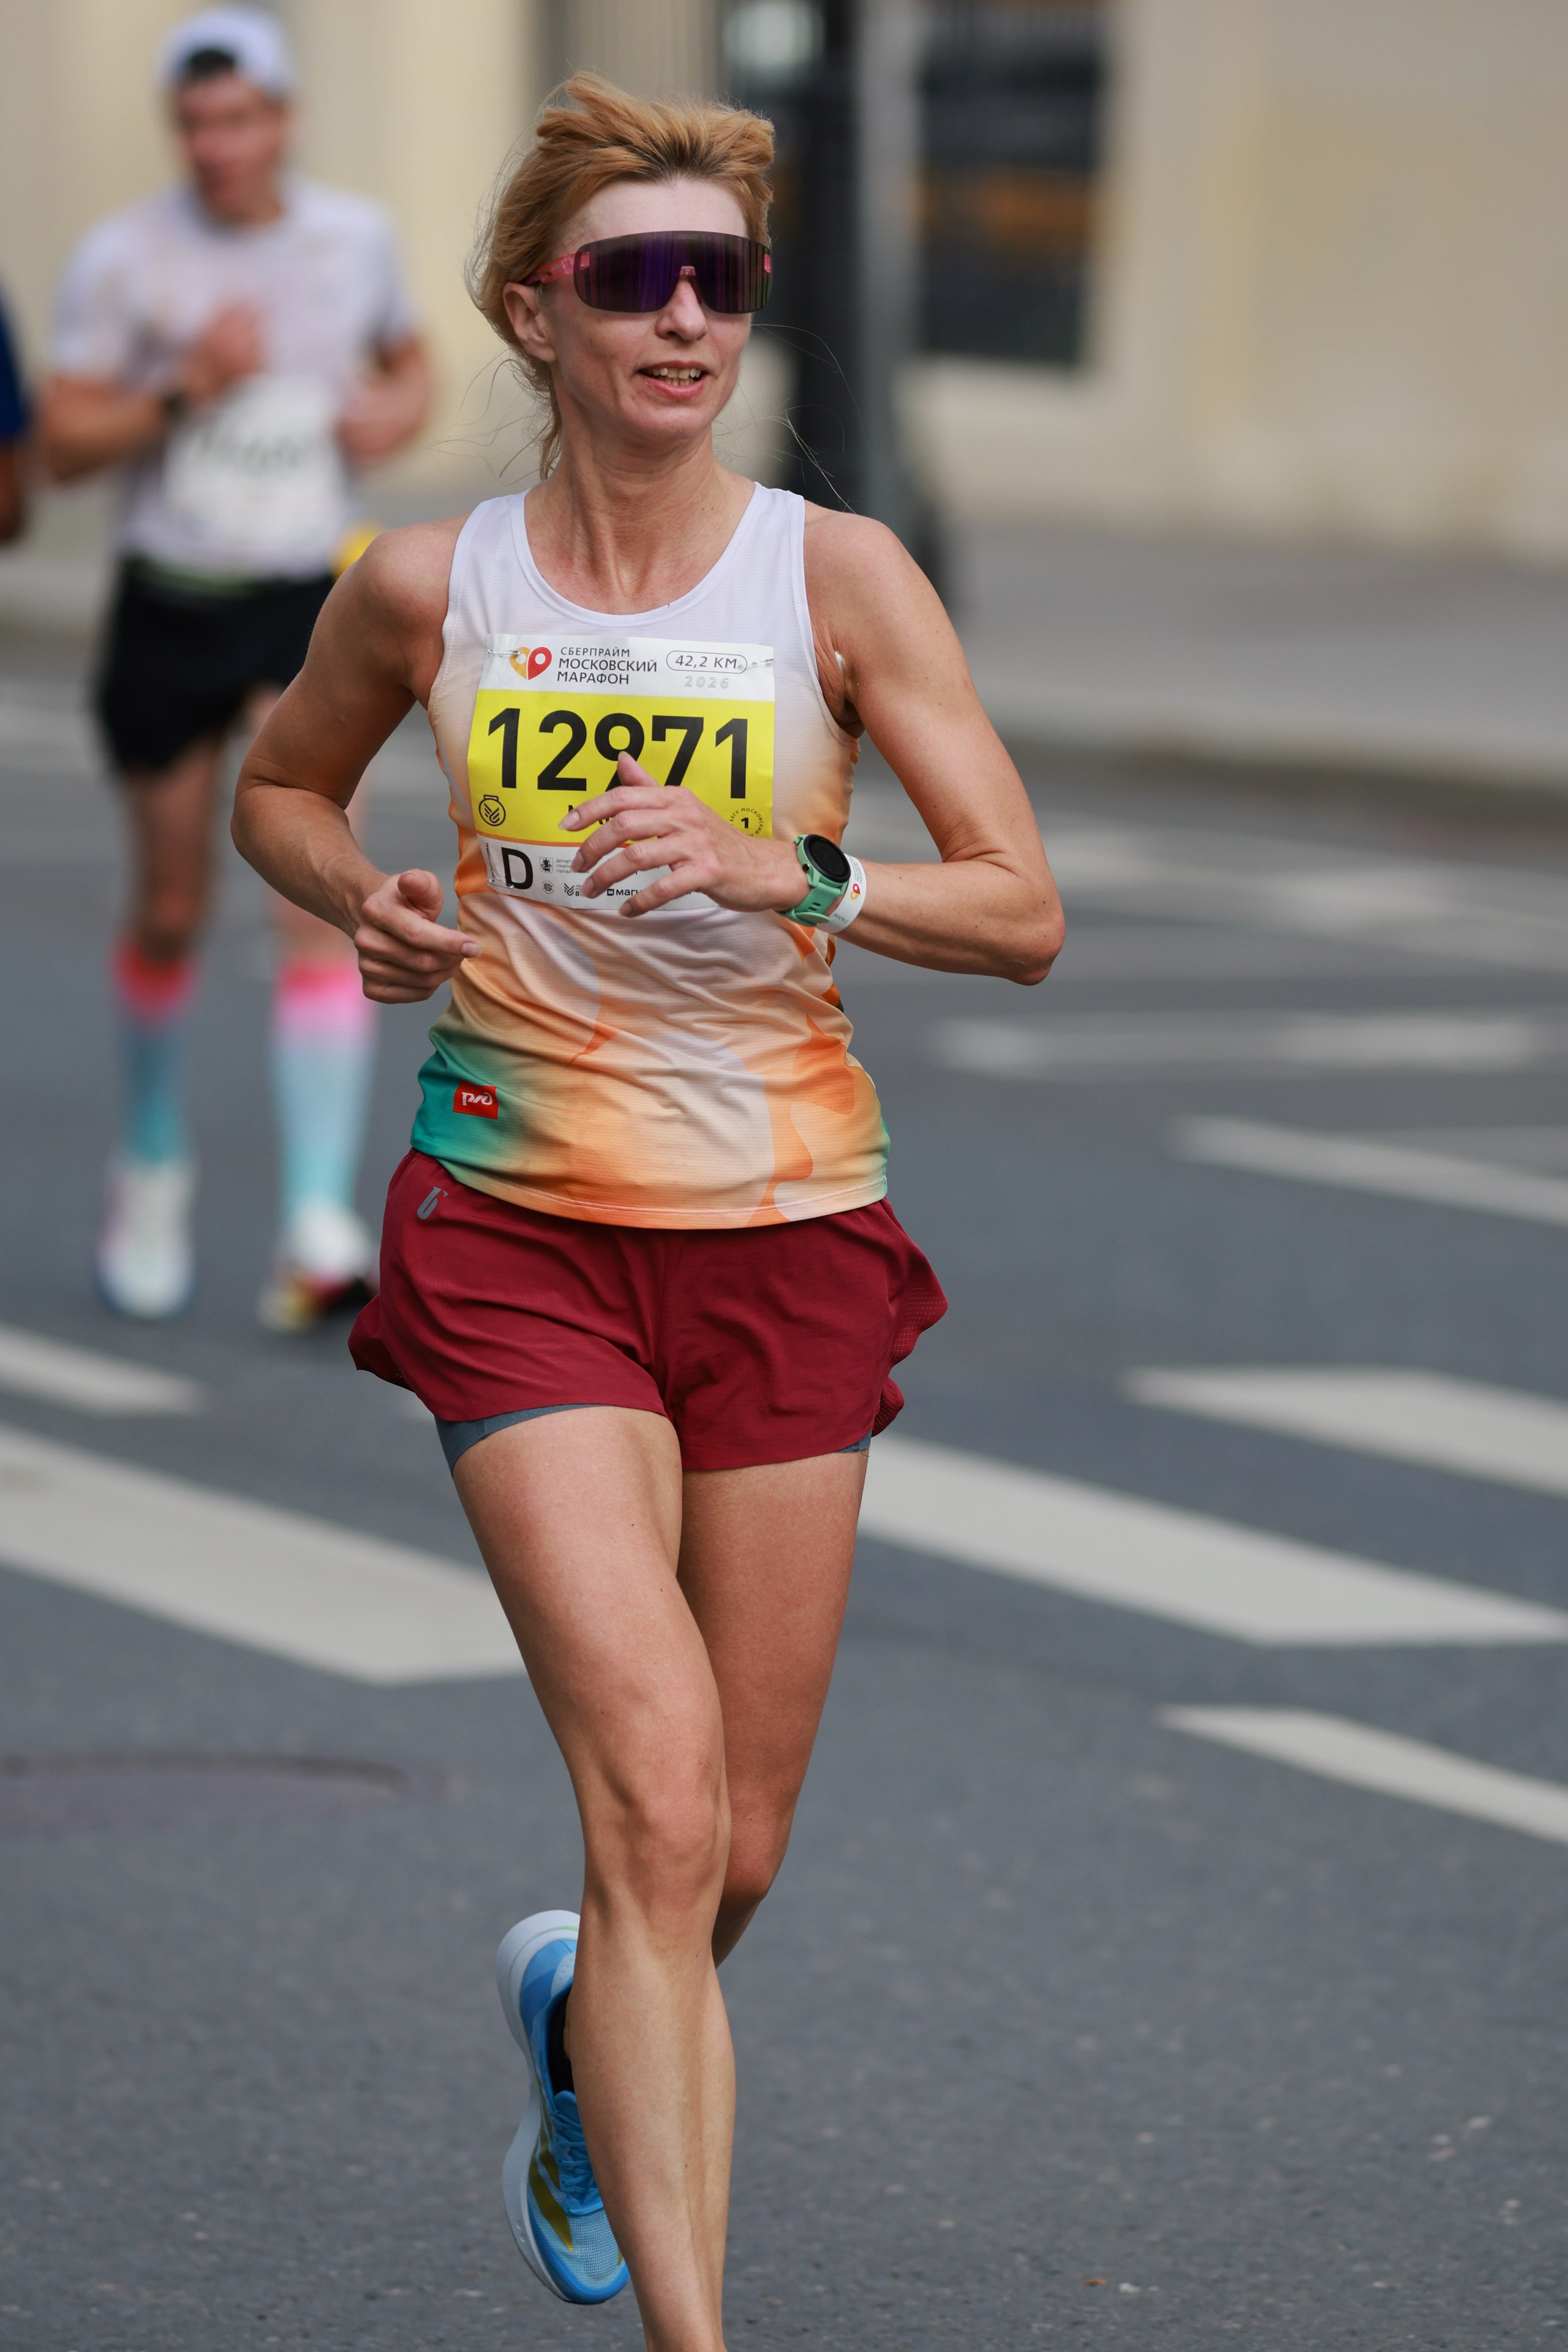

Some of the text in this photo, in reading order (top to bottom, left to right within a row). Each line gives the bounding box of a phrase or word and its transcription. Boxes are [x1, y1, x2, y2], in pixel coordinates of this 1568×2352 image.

[561, 647, 630, 657] СБЕРПРАЙМ
[559, 658, 657, 672] МОСКОВСКИЙ
[676, 655, 737, 669] 42,2 КМ
[557, 671, 629, 685] МАРАФОН
[684, 676, 729, 688] 2026
[488, 707, 748, 799] 12971
[741, 818, 748, 829] 1
[501, 846, 533, 890] D
